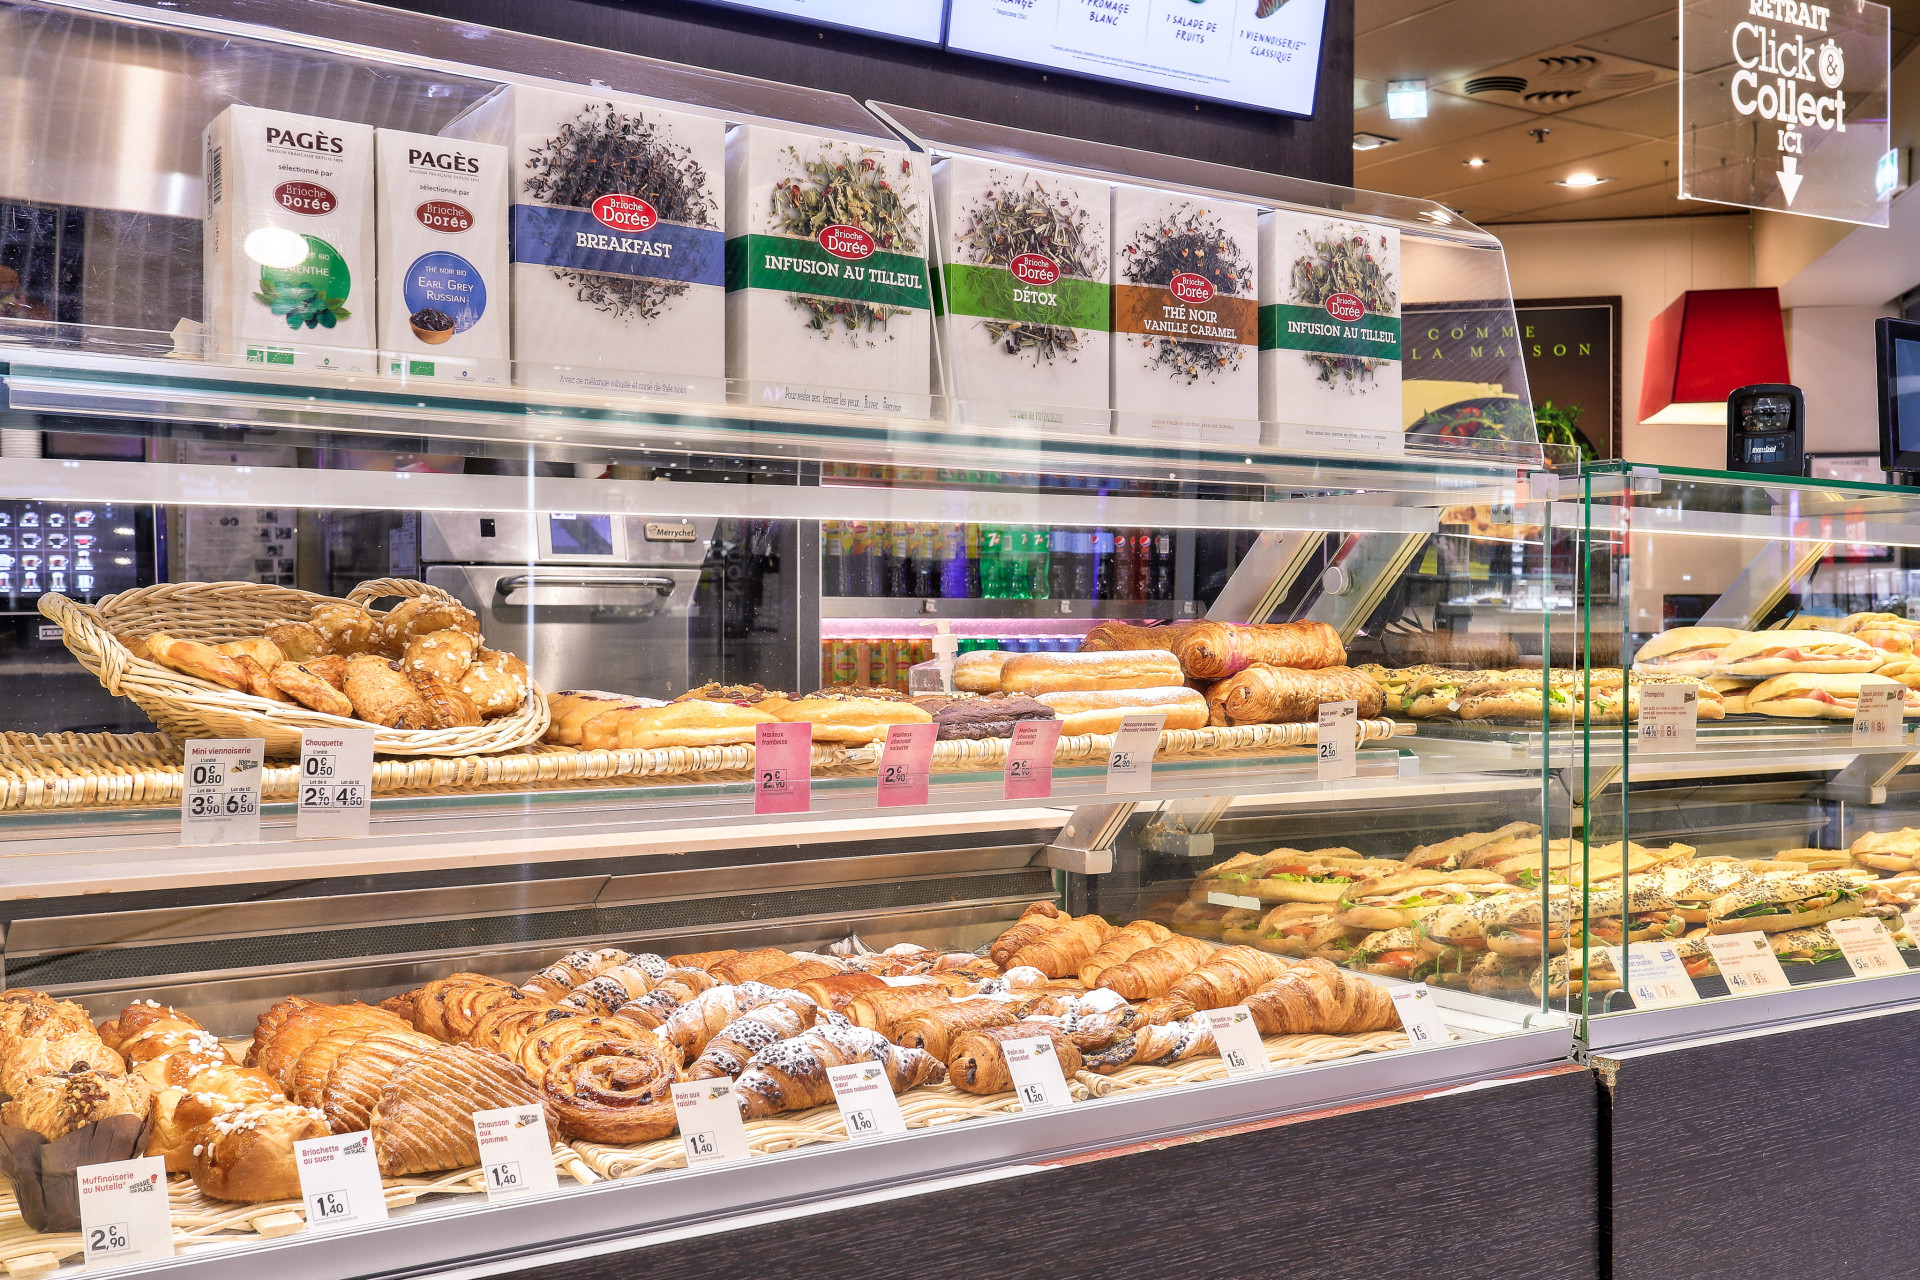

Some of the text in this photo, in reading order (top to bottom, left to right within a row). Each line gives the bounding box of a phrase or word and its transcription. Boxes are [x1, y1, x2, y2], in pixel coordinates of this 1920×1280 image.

[1089, 11, 1119, 26] BLANC
[1749, 0, 1830, 31] RETRAIT
[1172, 15, 1204, 30] SALADE
[1206, 22, 1218, 33] DE
[1175, 29, 1205, 44] FRUITS
[1250, 46, 1293, 63] CLASSIQUE
[1732, 21, 1816, 82] Click
[1731, 69, 1846, 132] Collect
[266, 127, 343, 153] PAGÈS
[408, 148, 479, 173] PAGÈS
[278, 164, 319, 175] sélectionné
[286, 184, 327, 199] Brioche
[419, 183, 457, 195] sélectionné
[282, 194, 331, 211] Dorée
[427, 203, 465, 217] Brioche
[610, 198, 644, 212] Brioche
[423, 213, 468, 229] Dorée
[602, 205, 650, 227] Dorée
[834, 228, 863, 241] Brioche
[576, 232, 673, 258] BREAKFAST
[828, 235, 868, 255] Dorée
[1024, 257, 1050, 268] Brioche
[425, 264, 467, 277] THÉ NOIR BIO
[764, 255, 923, 290] INFUSION AU TILLEUL
[1018, 263, 1054, 281] Dorée
[1182, 276, 1205, 287] Brioche
[1013, 286, 1058, 307] DÉTOX
[1177, 282, 1209, 299] Dorée
[1336, 296, 1357, 306] Brioche
[1163, 304, 1218, 324] THÉ NOIR
[1332, 302, 1360, 318] Dorée
[1144, 319, 1237, 339] VANILLE CARAMEL
[1288, 321, 1397, 344] INFUSION AU TILLEUL
[1428, 325, 1536, 341] COMME
[1412, 348, 1444, 360] LA
[656, 529, 695, 538] Merrychef
[192, 747, 251, 755] Mini viennoiserie
[305, 739, 344, 748] Chouquette
[832, 1073, 858, 1082] Croissant
[676, 1099, 697, 1108] raisins
[477, 1119, 510, 1129] Chausson
[480, 1135, 509, 1146] pommes
[302, 1145, 339, 1157] Briochette
[314, 1155, 335, 1163] sucre
[82, 1171, 134, 1186] Muffinoiserie
[137, 1184, 154, 1192] PLACE
